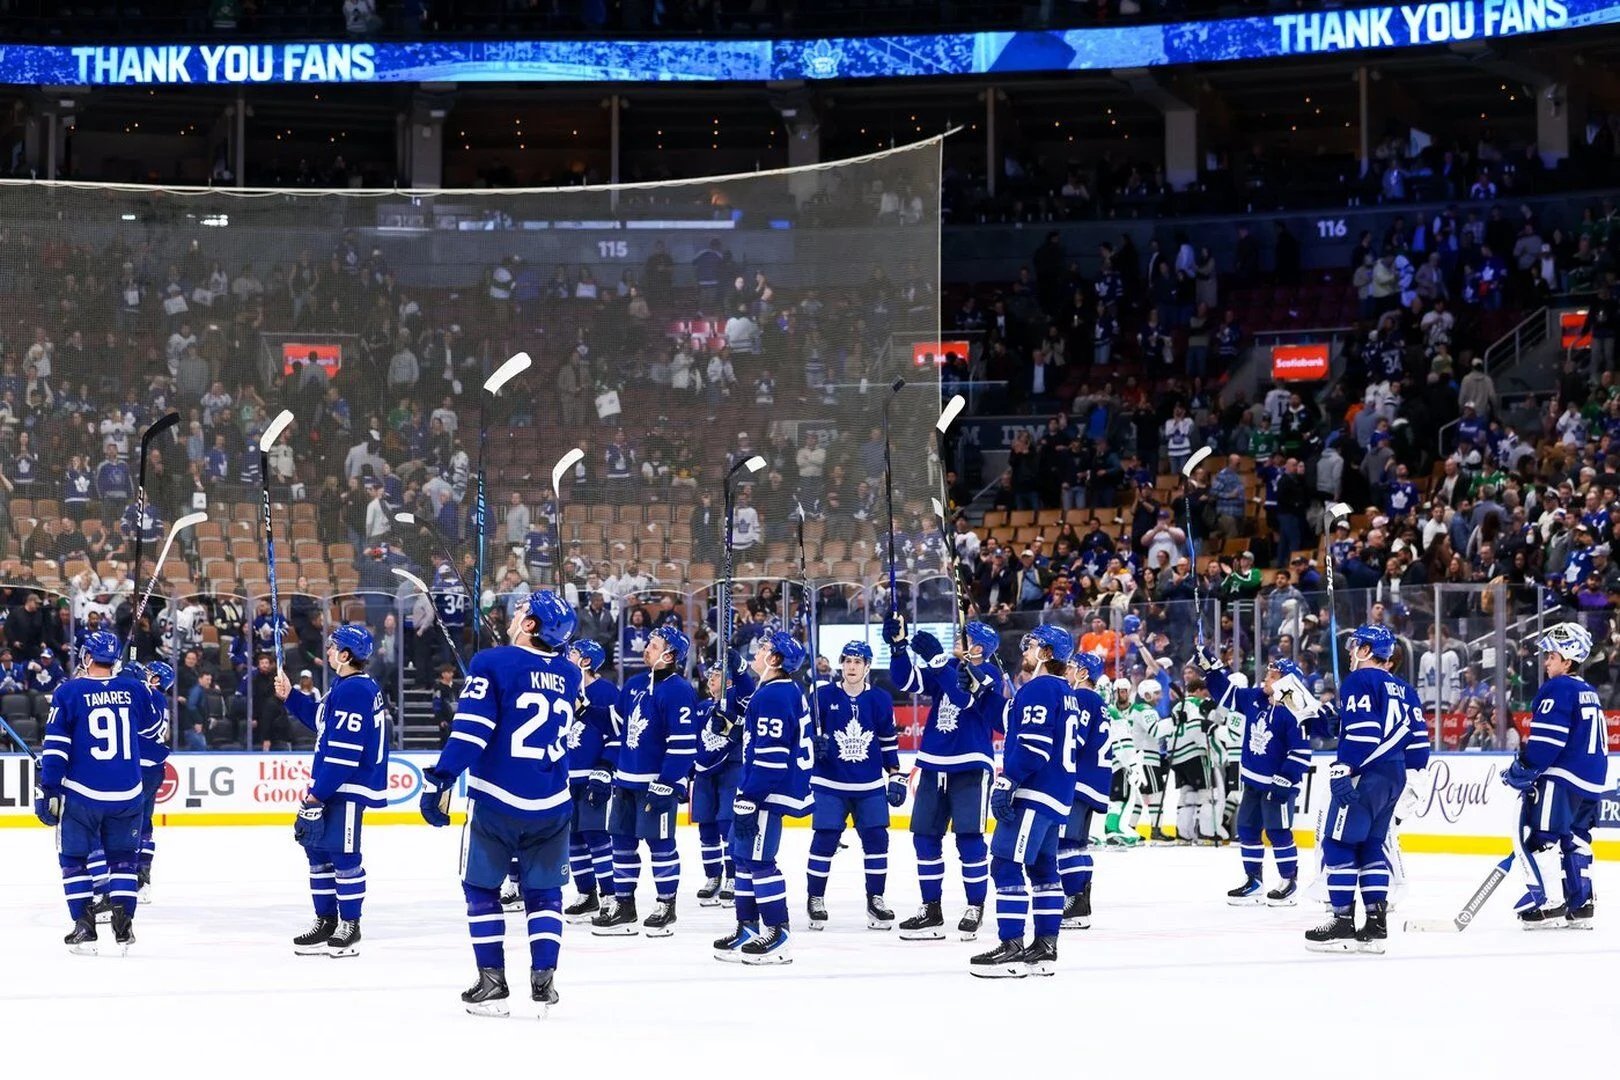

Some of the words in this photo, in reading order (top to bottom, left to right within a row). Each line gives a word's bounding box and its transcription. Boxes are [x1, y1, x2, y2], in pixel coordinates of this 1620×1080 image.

[1273, 8, 1393, 51] THANK
[1401, 1, 1474, 43] YOU
[1484, 0, 1568, 37] FANS
[72, 47, 192, 83] THANK
[200, 45, 273, 82] YOU
[284, 44, 375, 81] FANS
[1317, 220, 1347, 237] 116
[598, 241, 627, 257] 115
[1276, 357, 1324, 368] Scotiabank
[263, 490, 272, 532] CCM
[1326, 555, 1334, 596] CCM
[443, 594, 464, 615] 34
[459, 675, 489, 700] 23
[530, 671, 565, 694] KNIES
[84, 691, 132, 707] TAVARES
[1346, 694, 1371, 713] 44
[334, 711, 363, 732] 76
[511, 692, 574, 762] 23
[680, 707, 691, 724] 2
[757, 716, 784, 738] 53
[88, 707, 132, 760] 91
[1581, 707, 1609, 756] 70
[189, 766, 235, 796] LG
[259, 760, 311, 781] Life's
[1415, 760, 1496, 823] Royal
[1469, 871, 1501, 912] WARRIOR
